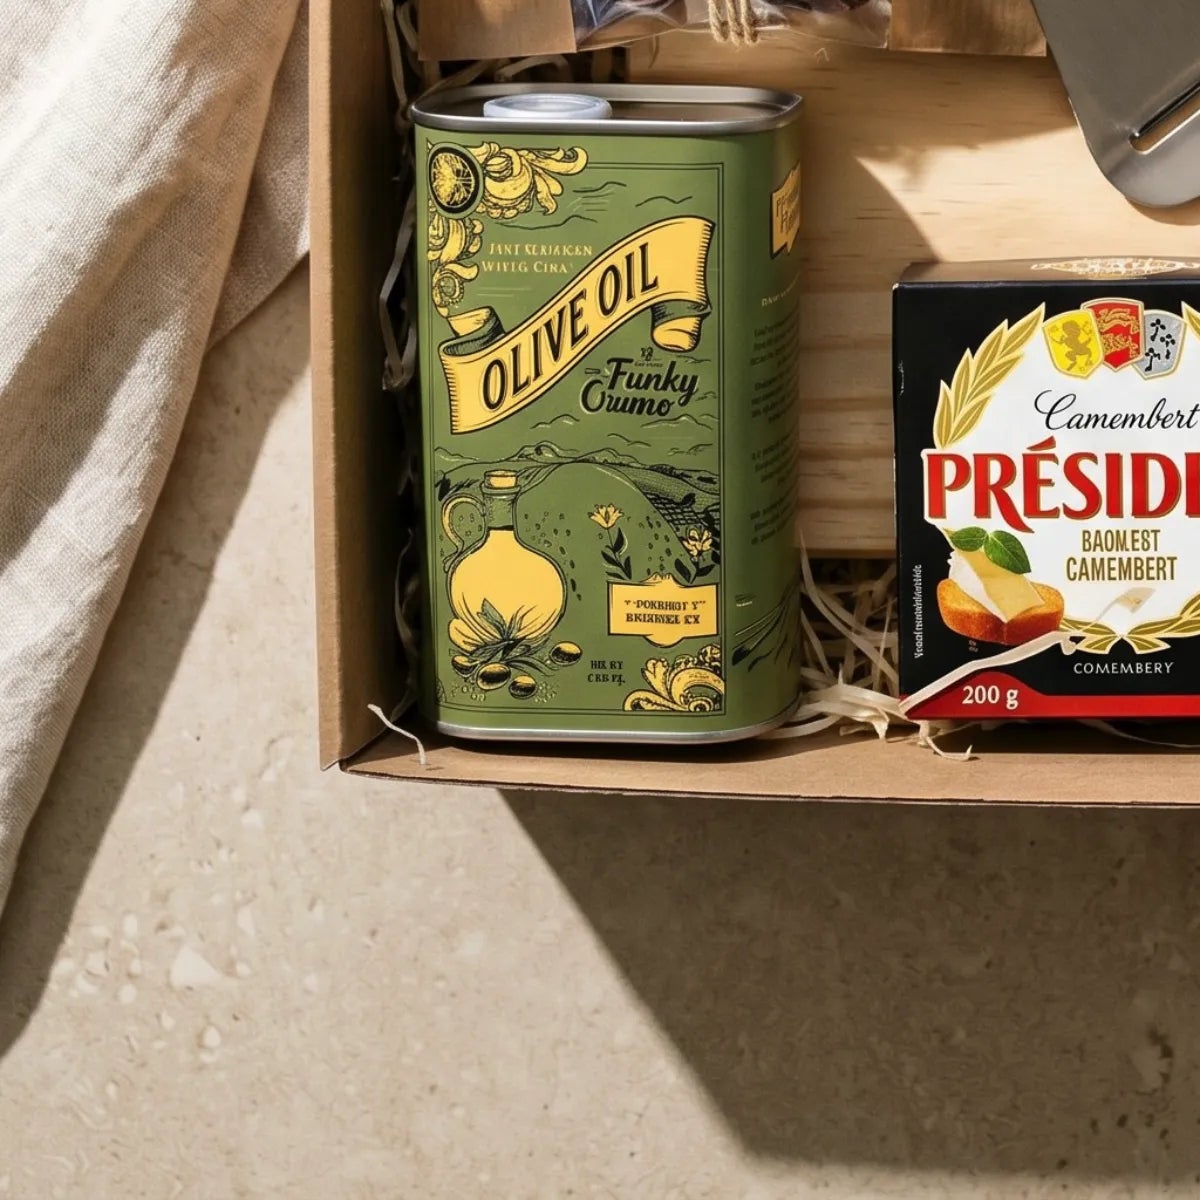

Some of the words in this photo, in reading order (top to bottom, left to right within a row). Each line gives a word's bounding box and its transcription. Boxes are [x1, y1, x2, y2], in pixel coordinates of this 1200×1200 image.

[482, 288, 590, 411] OLIVE
[598, 241, 660, 317] OIL
[607, 357, 699, 407] Funky
[1066, 557, 1178, 581] CAMEMBERT
[1074, 662, 1173, 675] COMEMBERY
[962, 685, 1001, 704] 200
[1005, 687, 1019, 709] g
